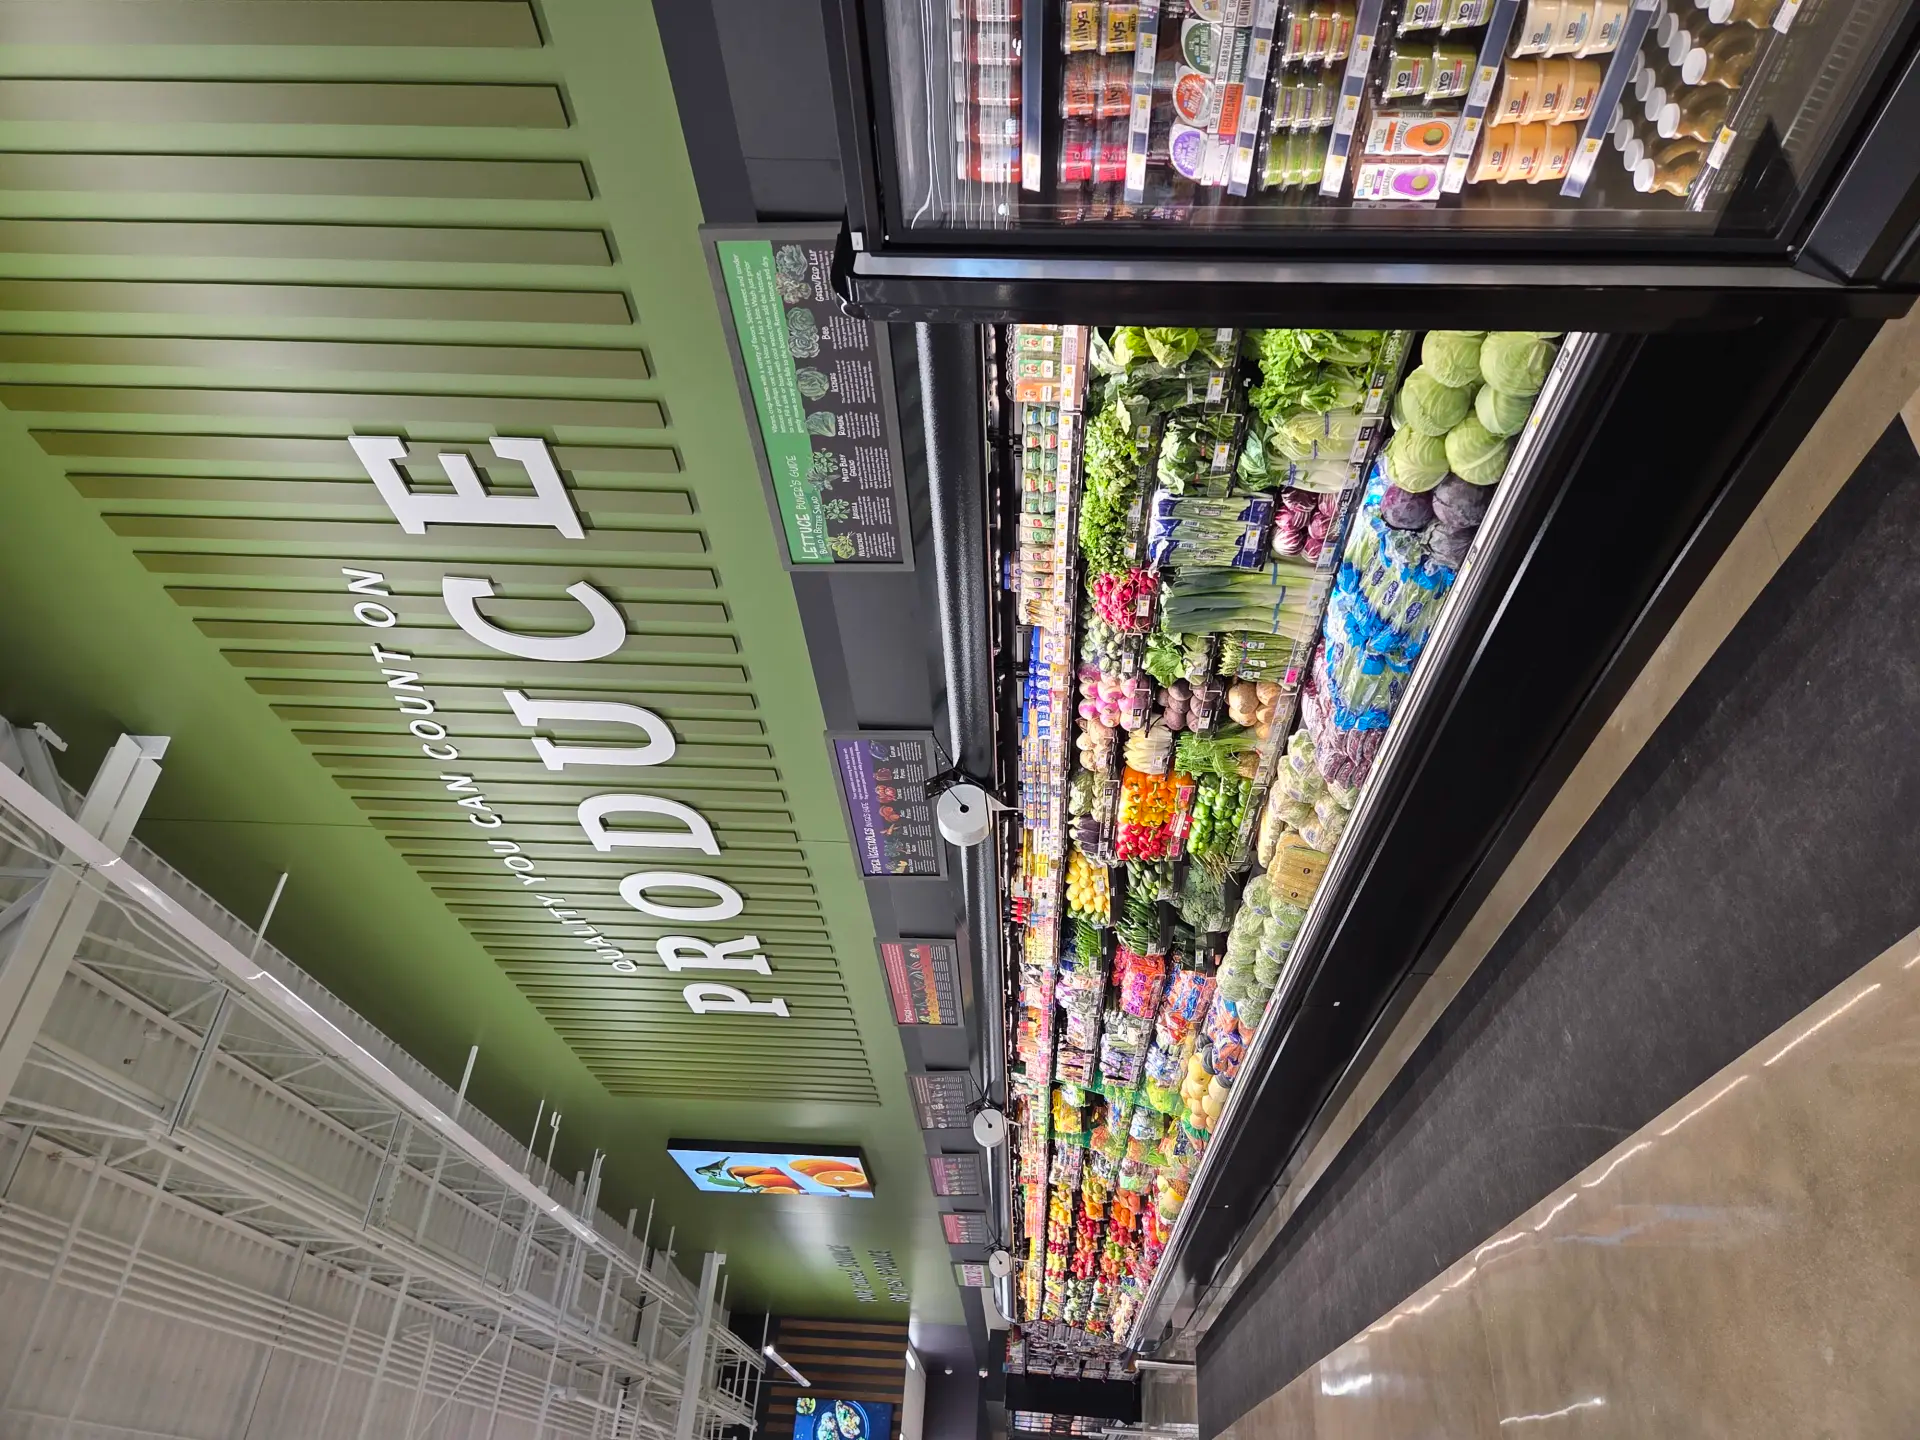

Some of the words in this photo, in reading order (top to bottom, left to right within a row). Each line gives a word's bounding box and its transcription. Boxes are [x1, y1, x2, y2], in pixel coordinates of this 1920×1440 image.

[1110, 22, 1126, 50] lly's
[1221, 50, 1229, 66] GRAB
[1232, 32, 1246, 74] GUACAMOLE
[1394, 121, 1409, 152] GUACAMOLE
[1382, 167, 1396, 196] GUACAMOLE
[1384, 339, 1399, 365] HARPS
[786, 455, 799, 477] GUIDE
[790, 480, 806, 510] BUYER'S
[811, 496, 821, 514] SALAD
[795, 514, 818, 558] LETTUCE
[813, 514, 822, 533] BETTER
[1334, 517, 1345, 536] HARPS
[342, 567, 397, 628] ON
[371, 645, 460, 761] COUNT
[347, 435, 790, 1017] PRODUCE
[440, 774, 502, 828] CAN
[864, 828, 880, 858] VEGETABLES
[488, 840, 547, 887] YOU
[536, 894, 638, 973] QUALITY
